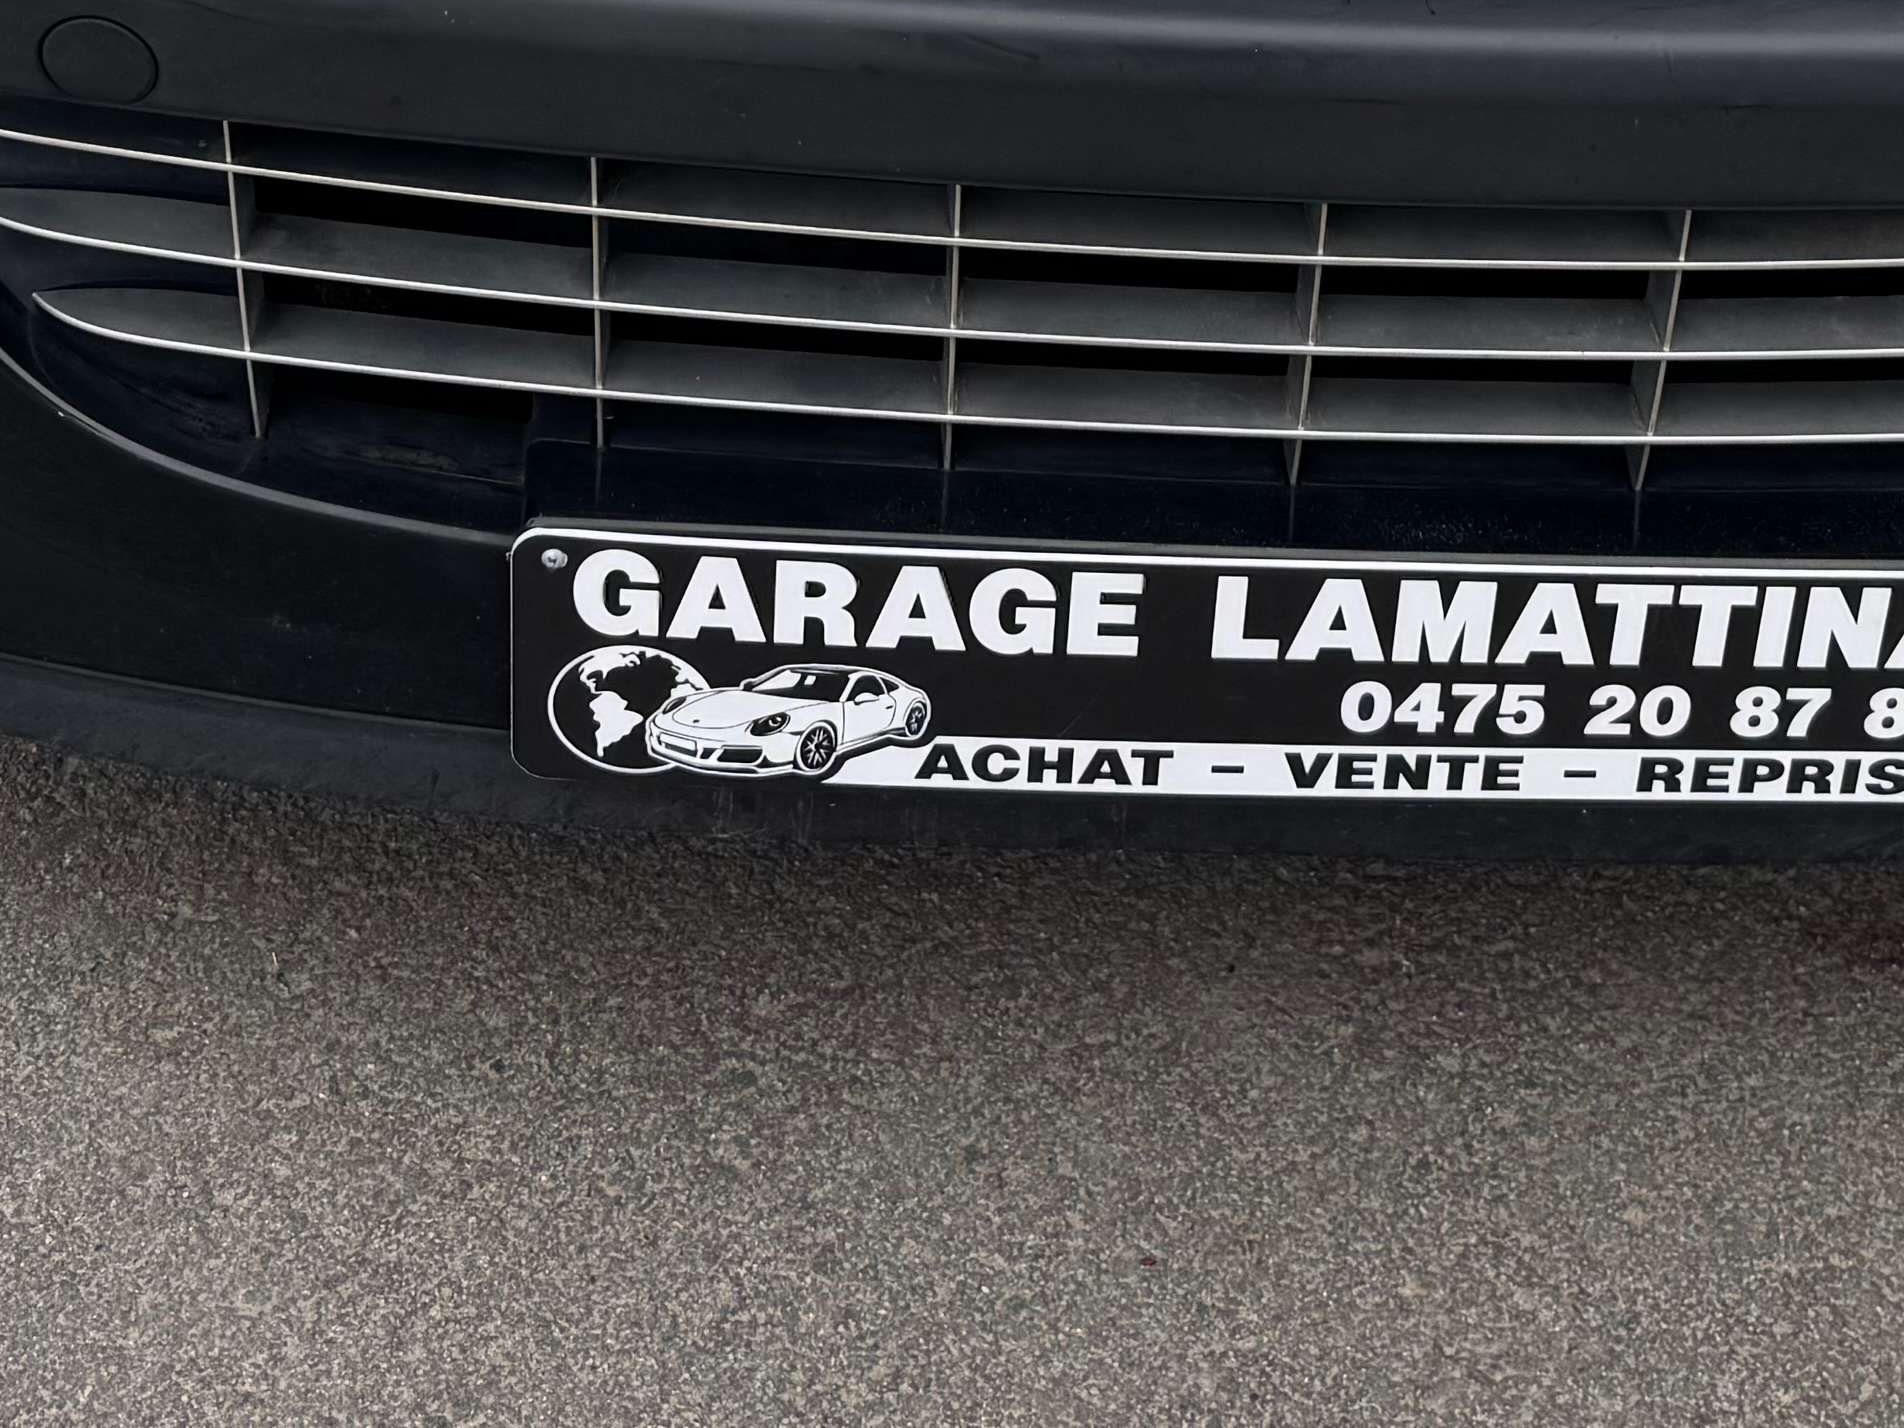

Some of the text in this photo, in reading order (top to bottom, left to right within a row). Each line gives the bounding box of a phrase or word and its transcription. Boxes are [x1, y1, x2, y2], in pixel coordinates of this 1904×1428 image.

[572, 548, 1144, 657] GARAGE
[1340, 680, 1546, 735] 0475
[1583, 684, 1692, 737] 20
[1729, 686, 1832, 738] 87
[914, 743, 1174, 786] ACHAT
[1284, 752, 1524, 792] VENTE
